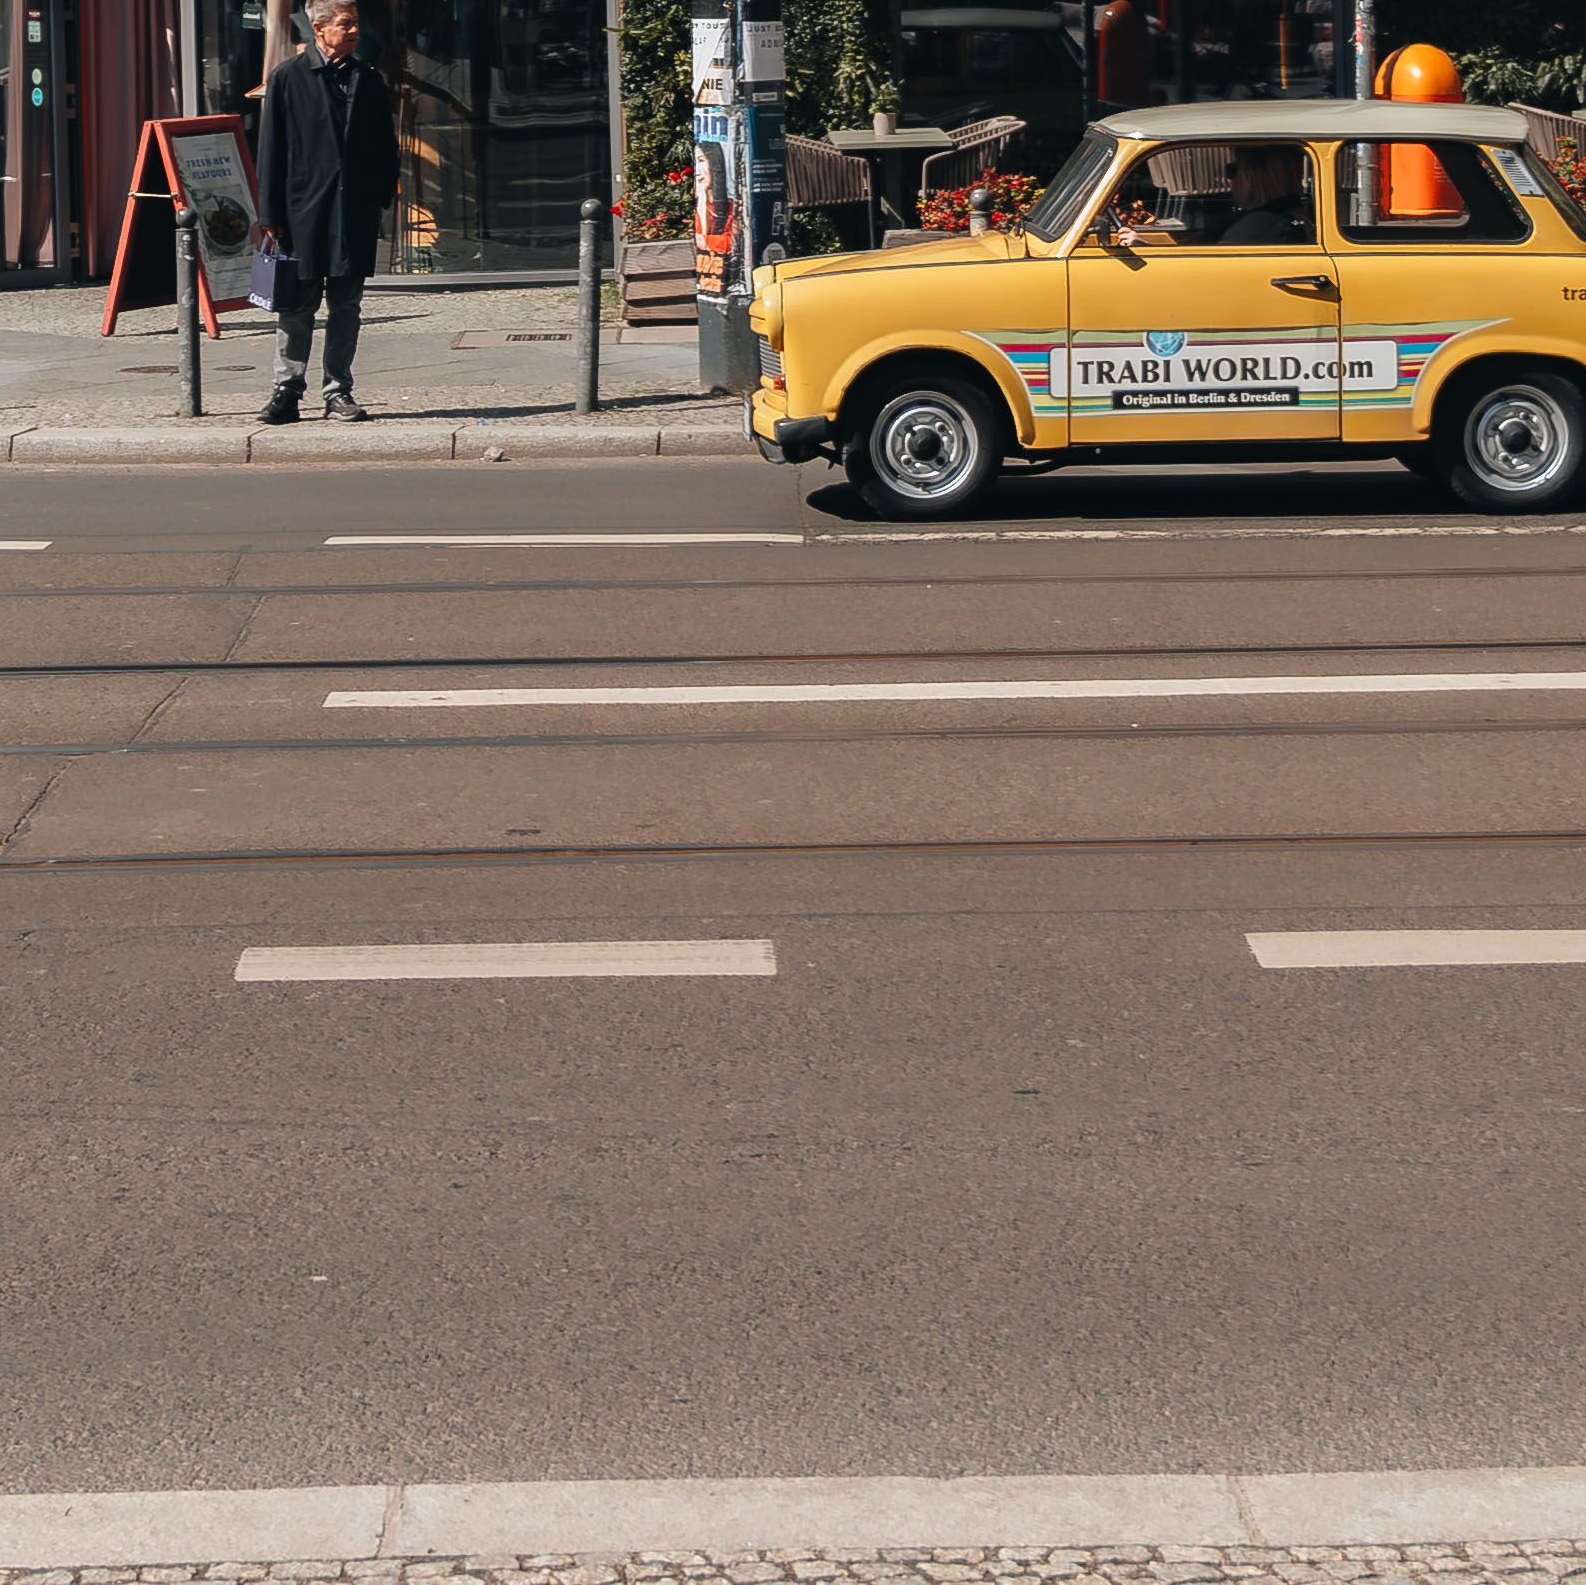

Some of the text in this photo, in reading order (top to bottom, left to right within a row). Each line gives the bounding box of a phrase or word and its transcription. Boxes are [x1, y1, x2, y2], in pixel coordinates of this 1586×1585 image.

[1077, 356, 1374, 385] TRABI WORLD.com
[1122, 391, 1290, 406] Original in Berlin & Dresden
